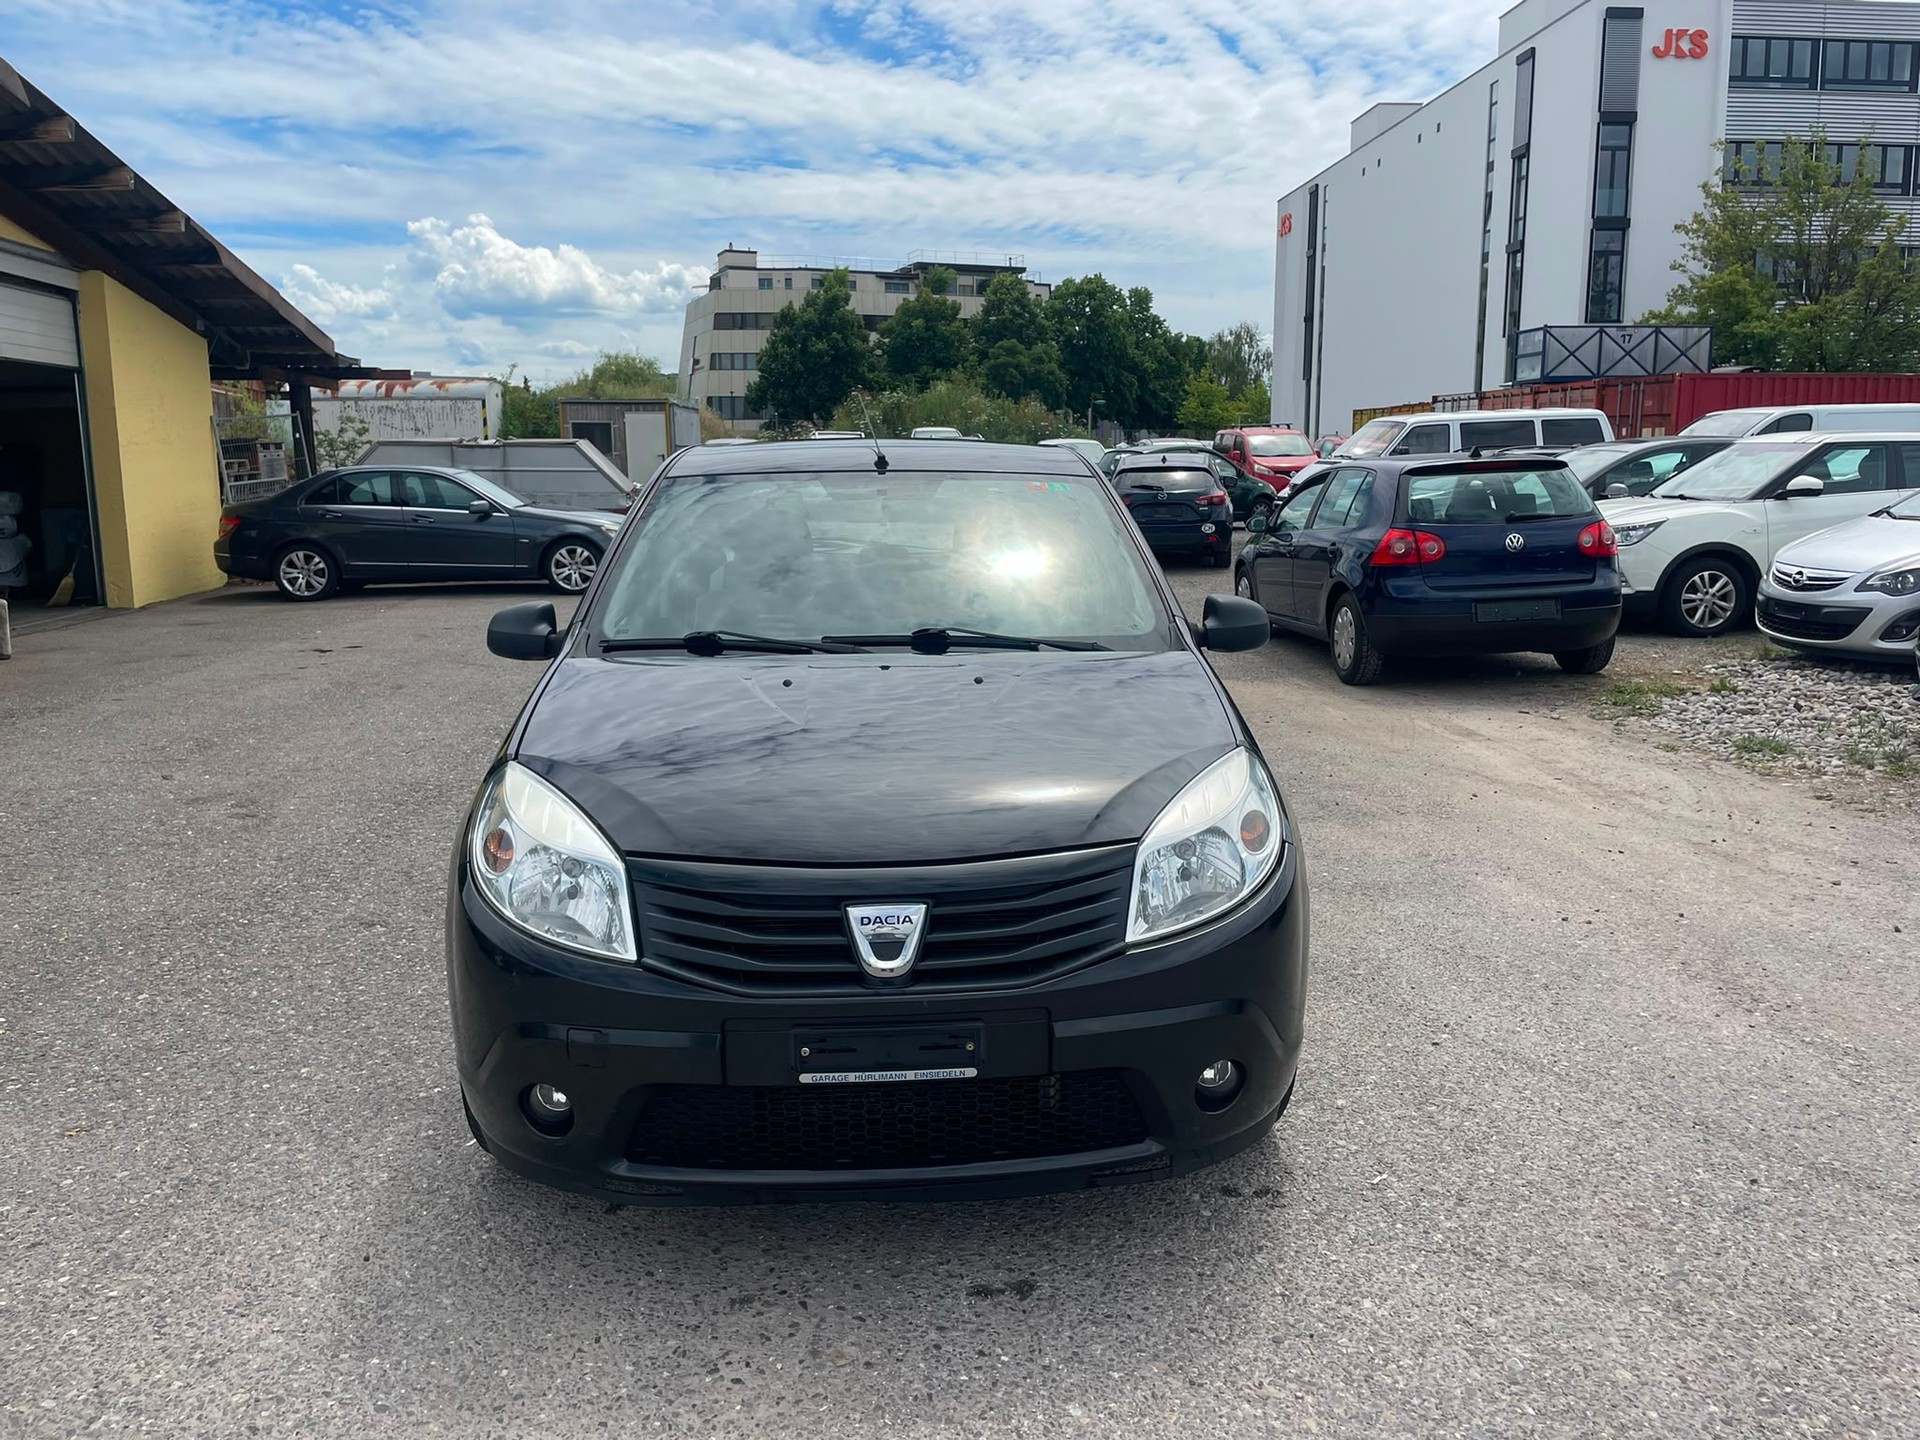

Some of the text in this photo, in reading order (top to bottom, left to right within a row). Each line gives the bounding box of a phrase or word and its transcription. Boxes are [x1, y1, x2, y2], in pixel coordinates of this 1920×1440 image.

[1652, 28, 1709, 59] JKS
[1620, 333, 1633, 344] 17
[860, 915, 914, 926] DACIA
[811, 1069, 966, 1082] GARAGE HÜRLIMANN EINSIEDELN
